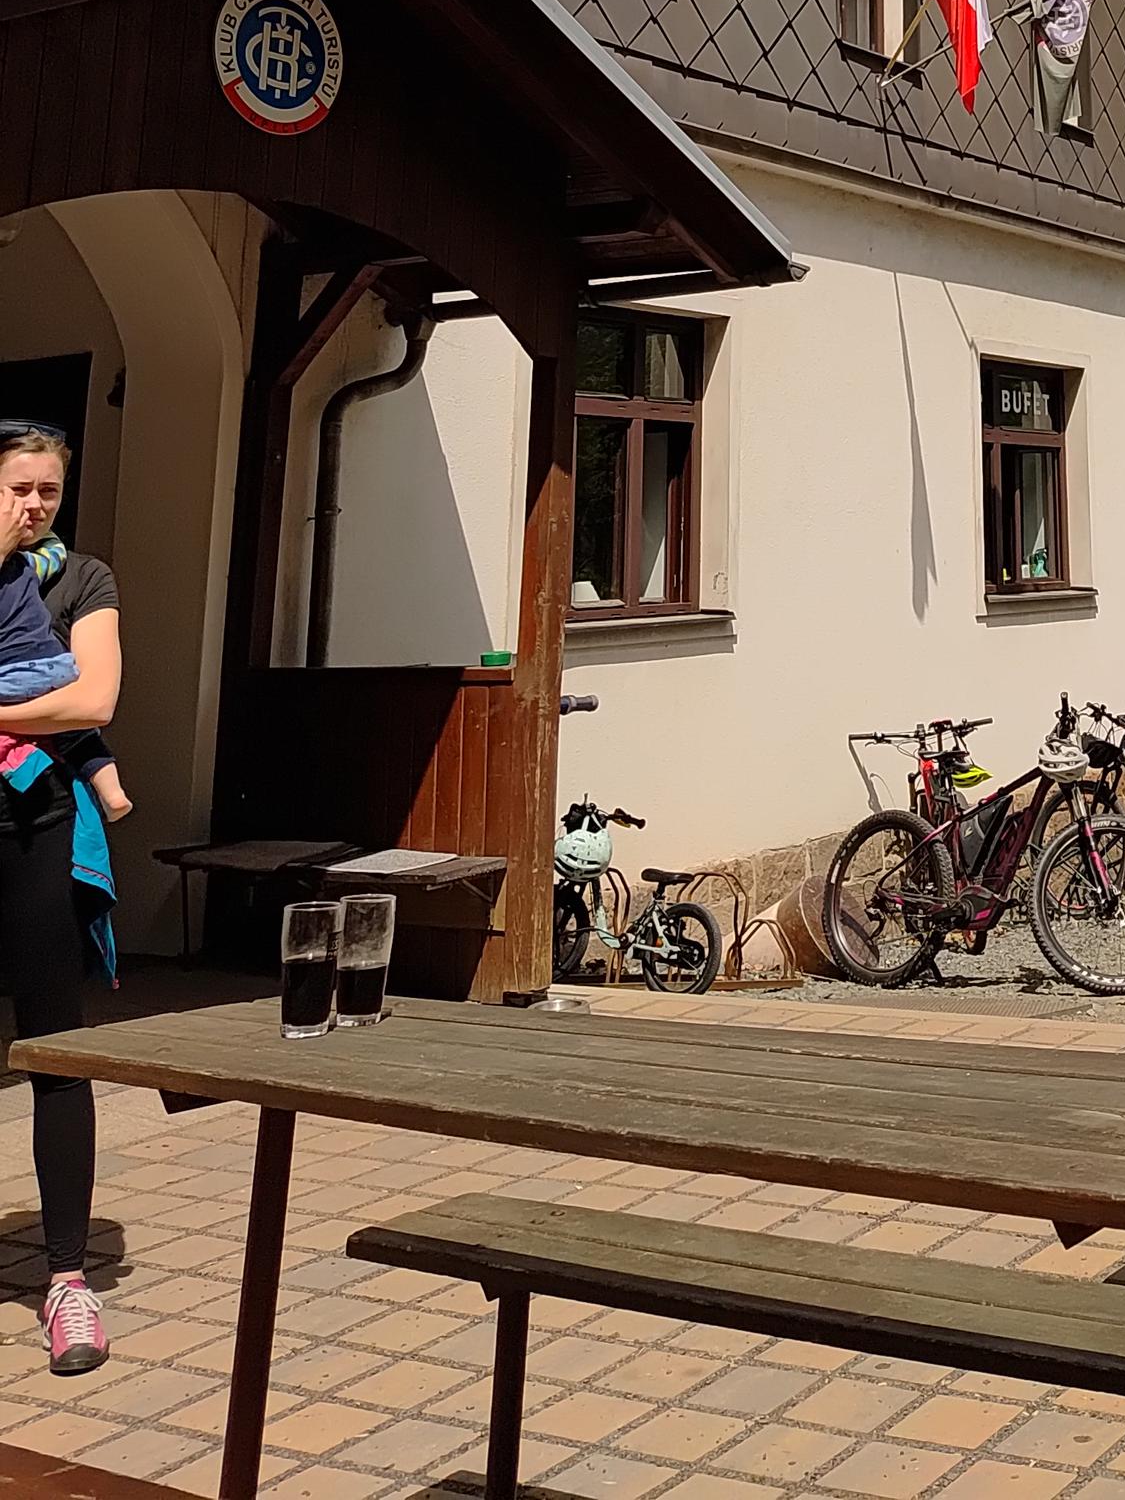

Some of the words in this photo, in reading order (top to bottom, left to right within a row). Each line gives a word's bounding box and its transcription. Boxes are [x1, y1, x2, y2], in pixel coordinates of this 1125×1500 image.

[222, 13, 237, 74] KLUB
[315, 7, 339, 100] TURISTŮ
[1001, 389, 1050, 416] BUFET
